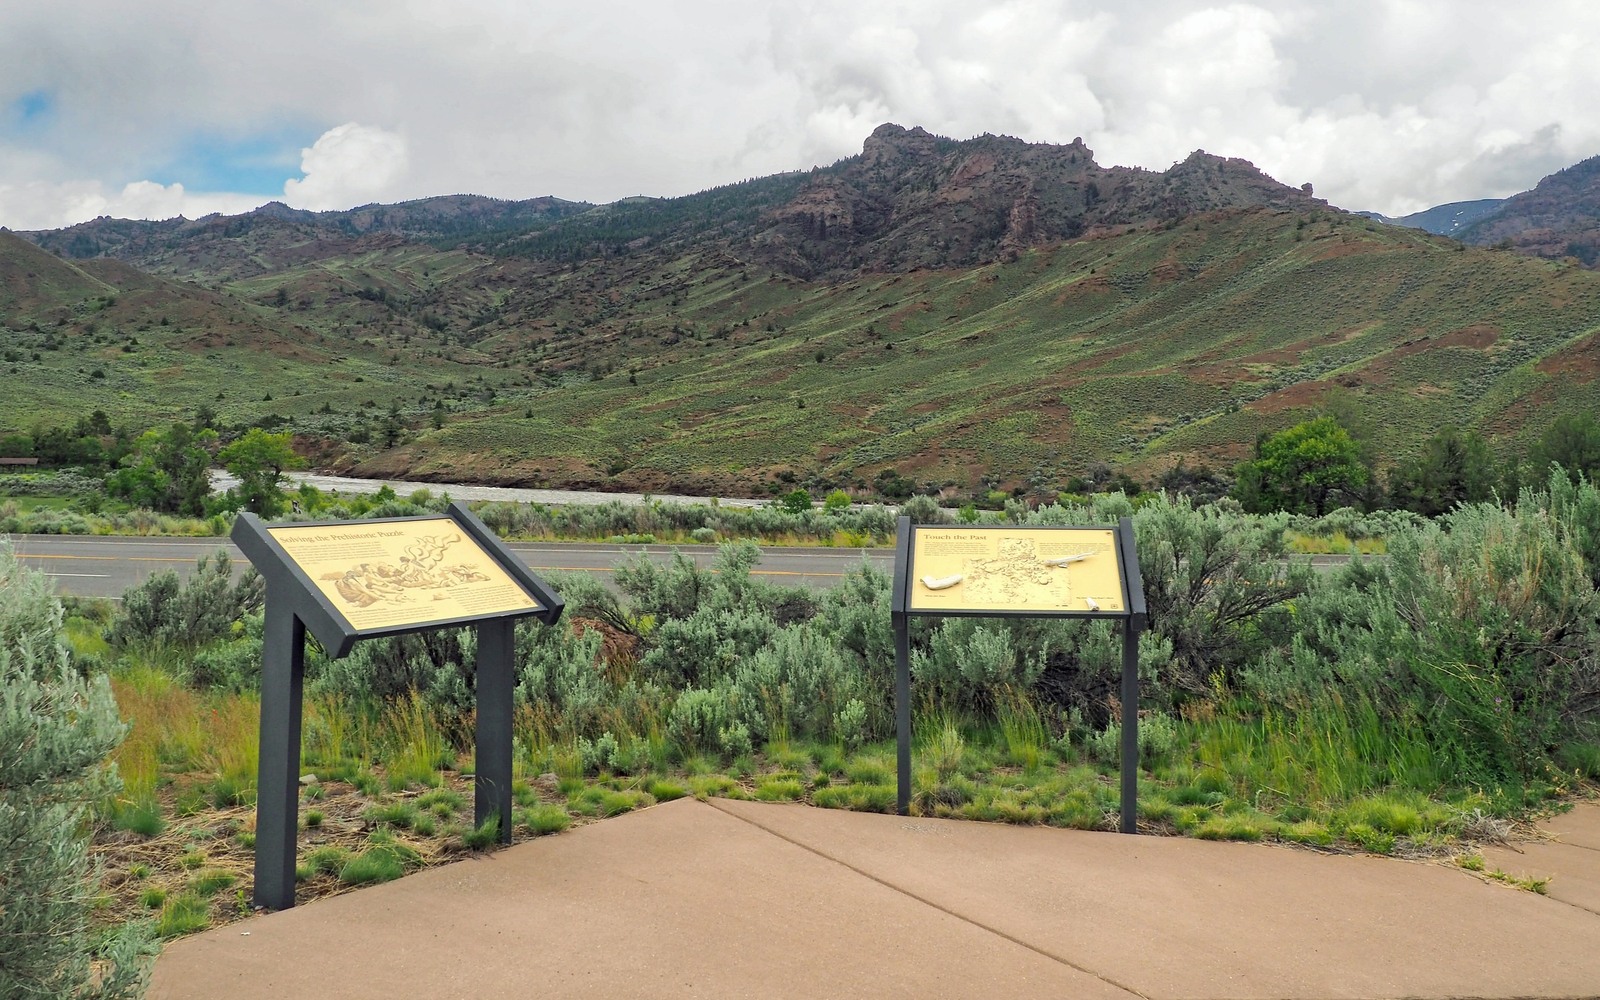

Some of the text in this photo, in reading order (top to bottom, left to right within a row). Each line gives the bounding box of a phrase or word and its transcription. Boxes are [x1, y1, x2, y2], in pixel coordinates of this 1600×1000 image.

[280, 535, 315, 544] Solving
[331, 532, 377, 541] Prehistoric
[377, 530, 404, 538] Puzzle
